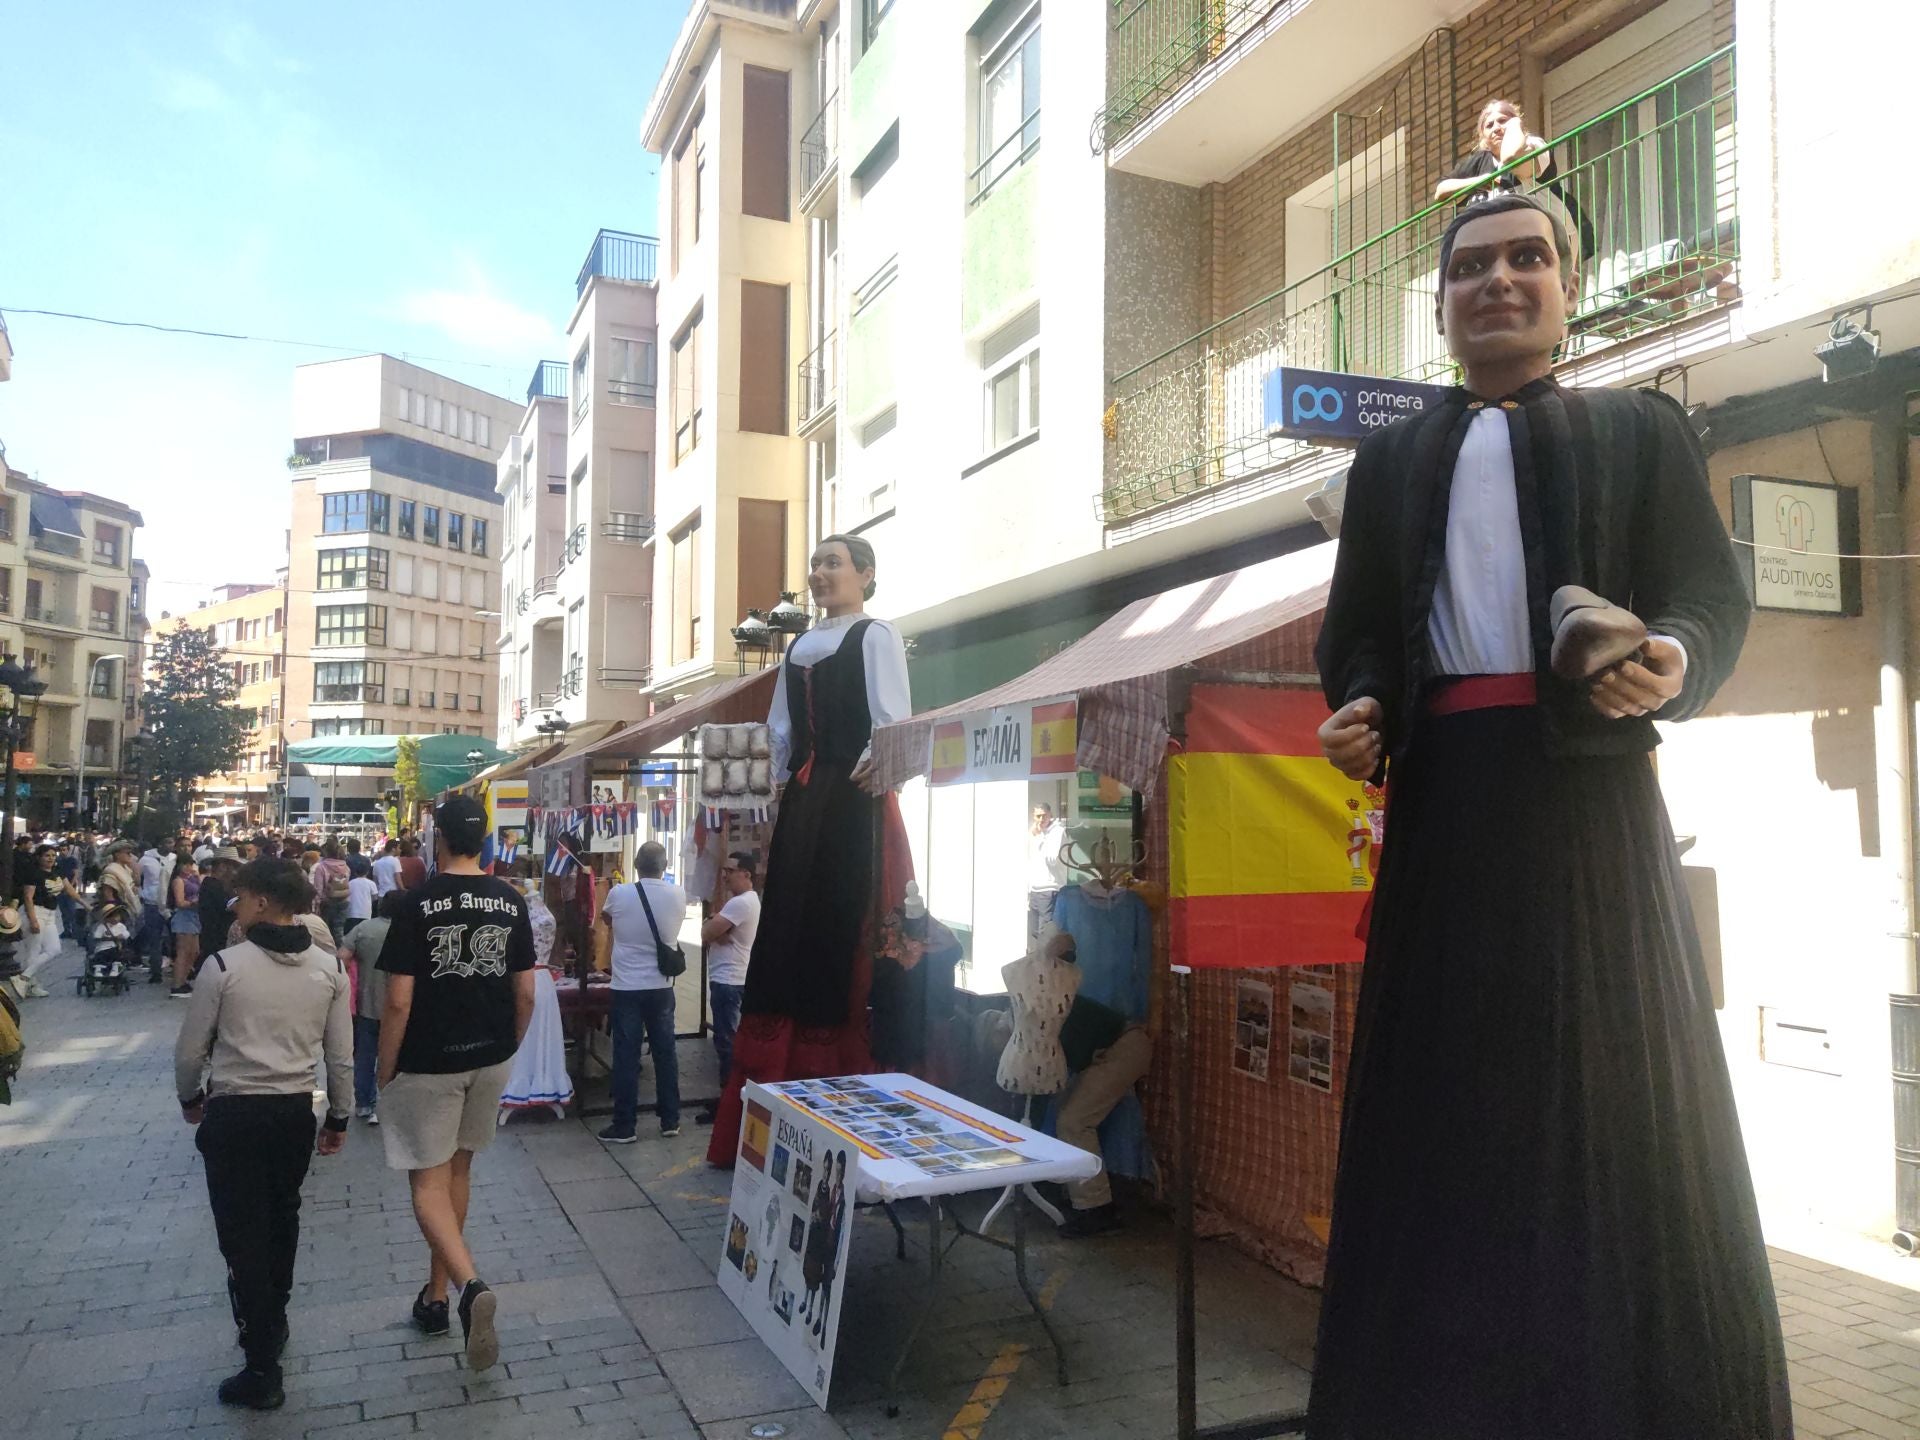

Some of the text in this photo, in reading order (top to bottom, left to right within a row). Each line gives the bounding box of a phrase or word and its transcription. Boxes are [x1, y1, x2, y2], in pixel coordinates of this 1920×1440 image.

[1357, 389, 1423, 410] primera
[1759, 556, 1788, 566] CENTROS
[1760, 567, 1834, 589] AUDITIVOS
[973, 715, 1021, 768] ESPAÑA
[420, 892, 518, 918] Los Angeles
[777, 1118, 813, 1162] ESPAÑA
